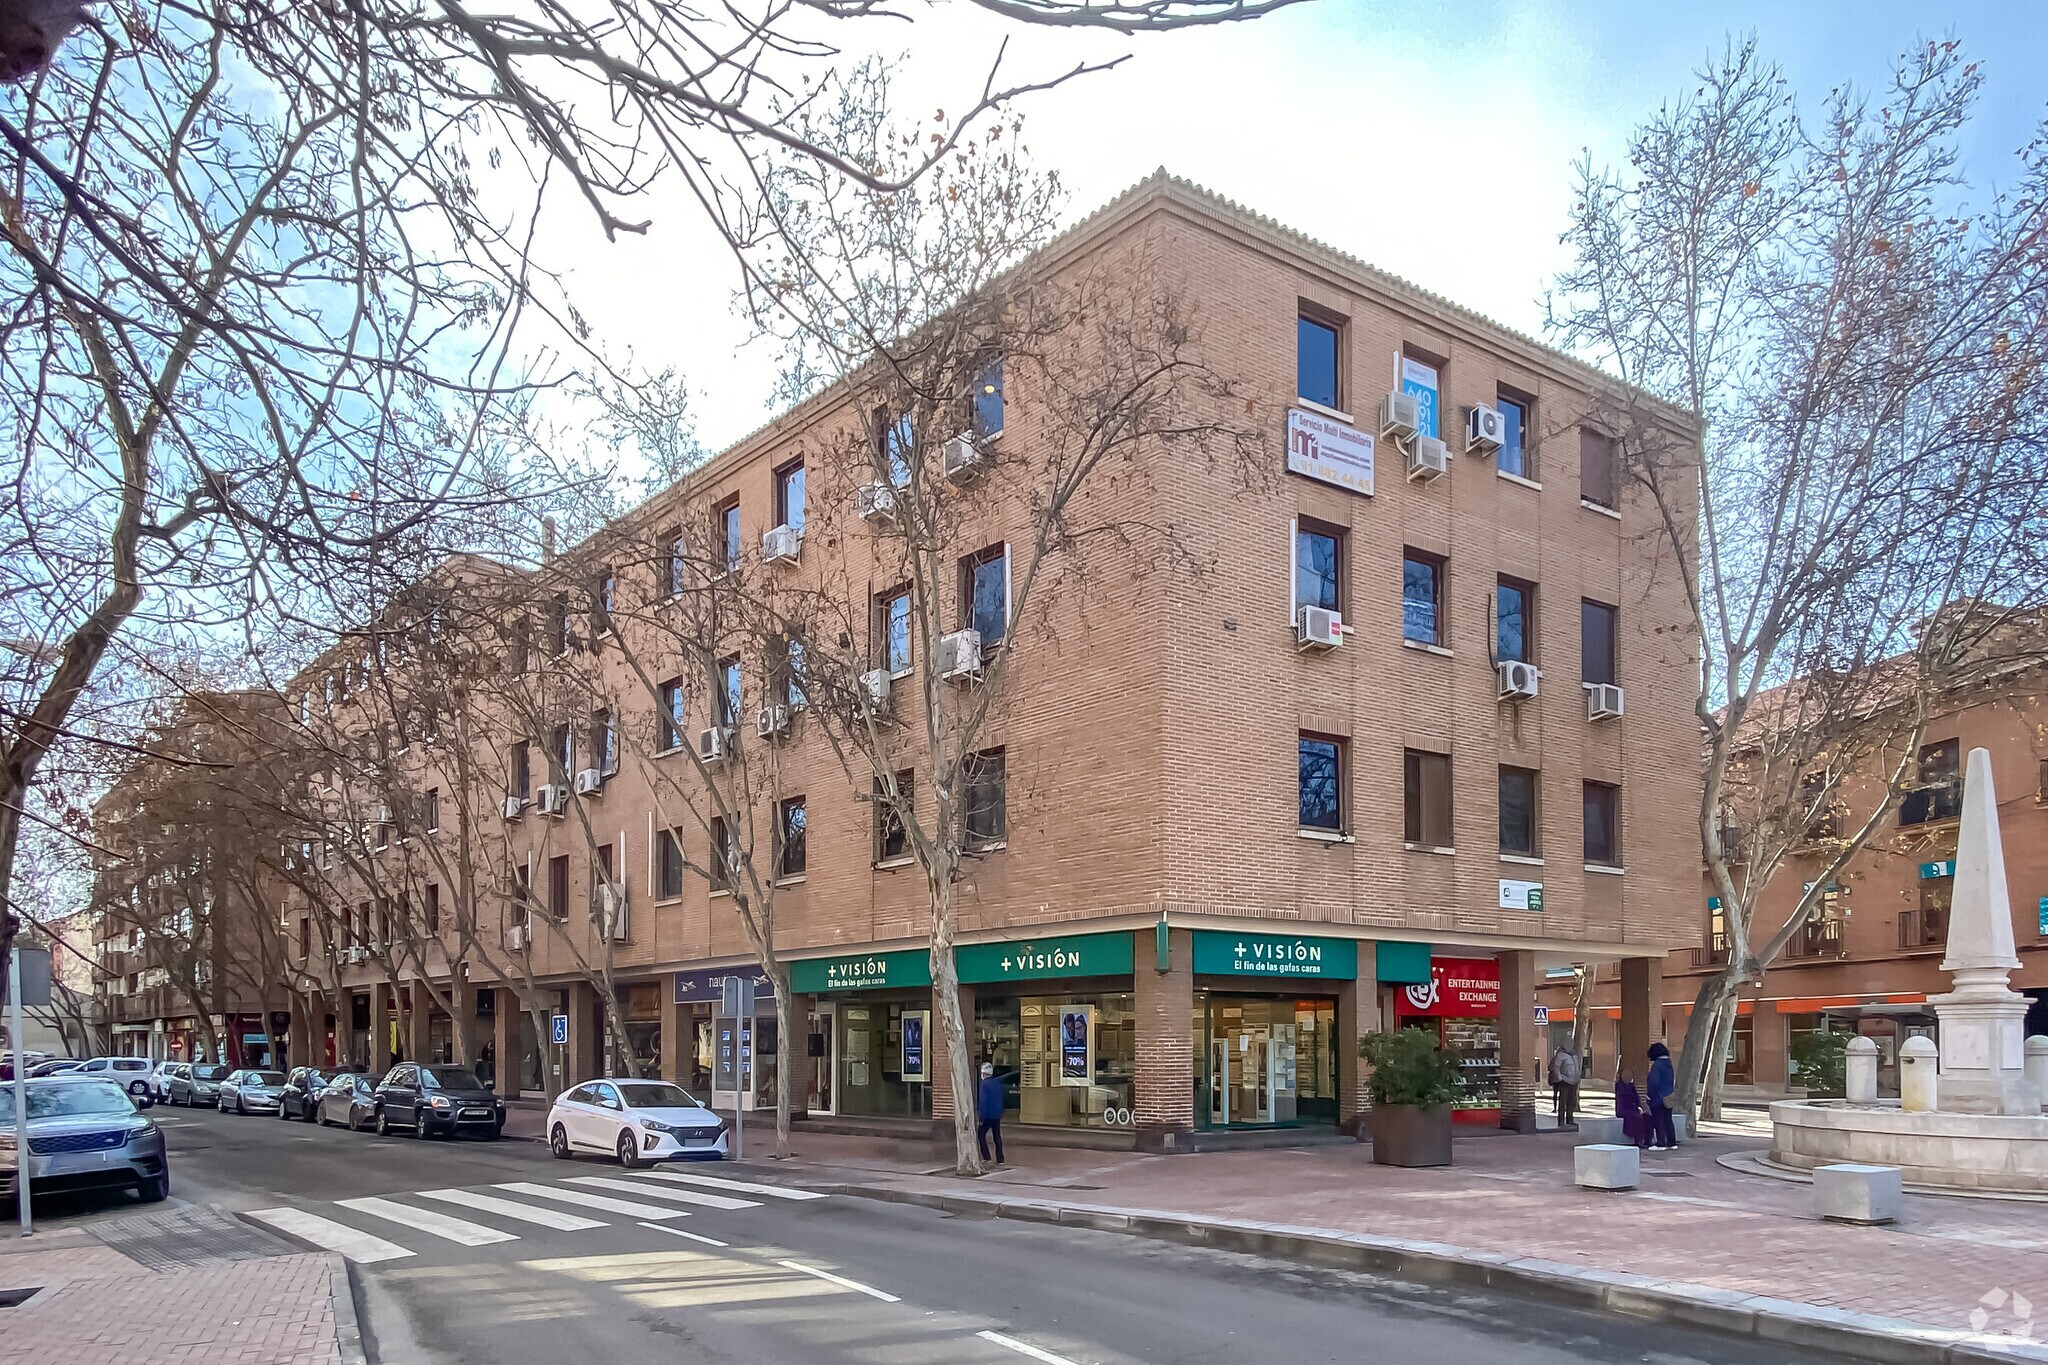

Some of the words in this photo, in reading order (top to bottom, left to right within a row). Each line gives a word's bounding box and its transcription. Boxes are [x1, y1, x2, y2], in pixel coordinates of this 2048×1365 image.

[1253, 941, 1320, 960] VISIÓN
[1016, 948, 1079, 970] VISIÓN
[840, 958, 886, 976] VISIÓN
[1234, 960, 1242, 969] El
[1244, 961, 1254, 970] fin
[1256, 962, 1265, 970] de
[1267, 962, 1278, 971] las
[1280, 963, 1300, 973] gafas
[1301, 965, 1320, 973] caras
[1448, 979, 1500, 989] ENTERTAINME
[1459, 992, 1497, 1002] EXCHANGE
[1067, 1057, 1085, 1066] -70%
